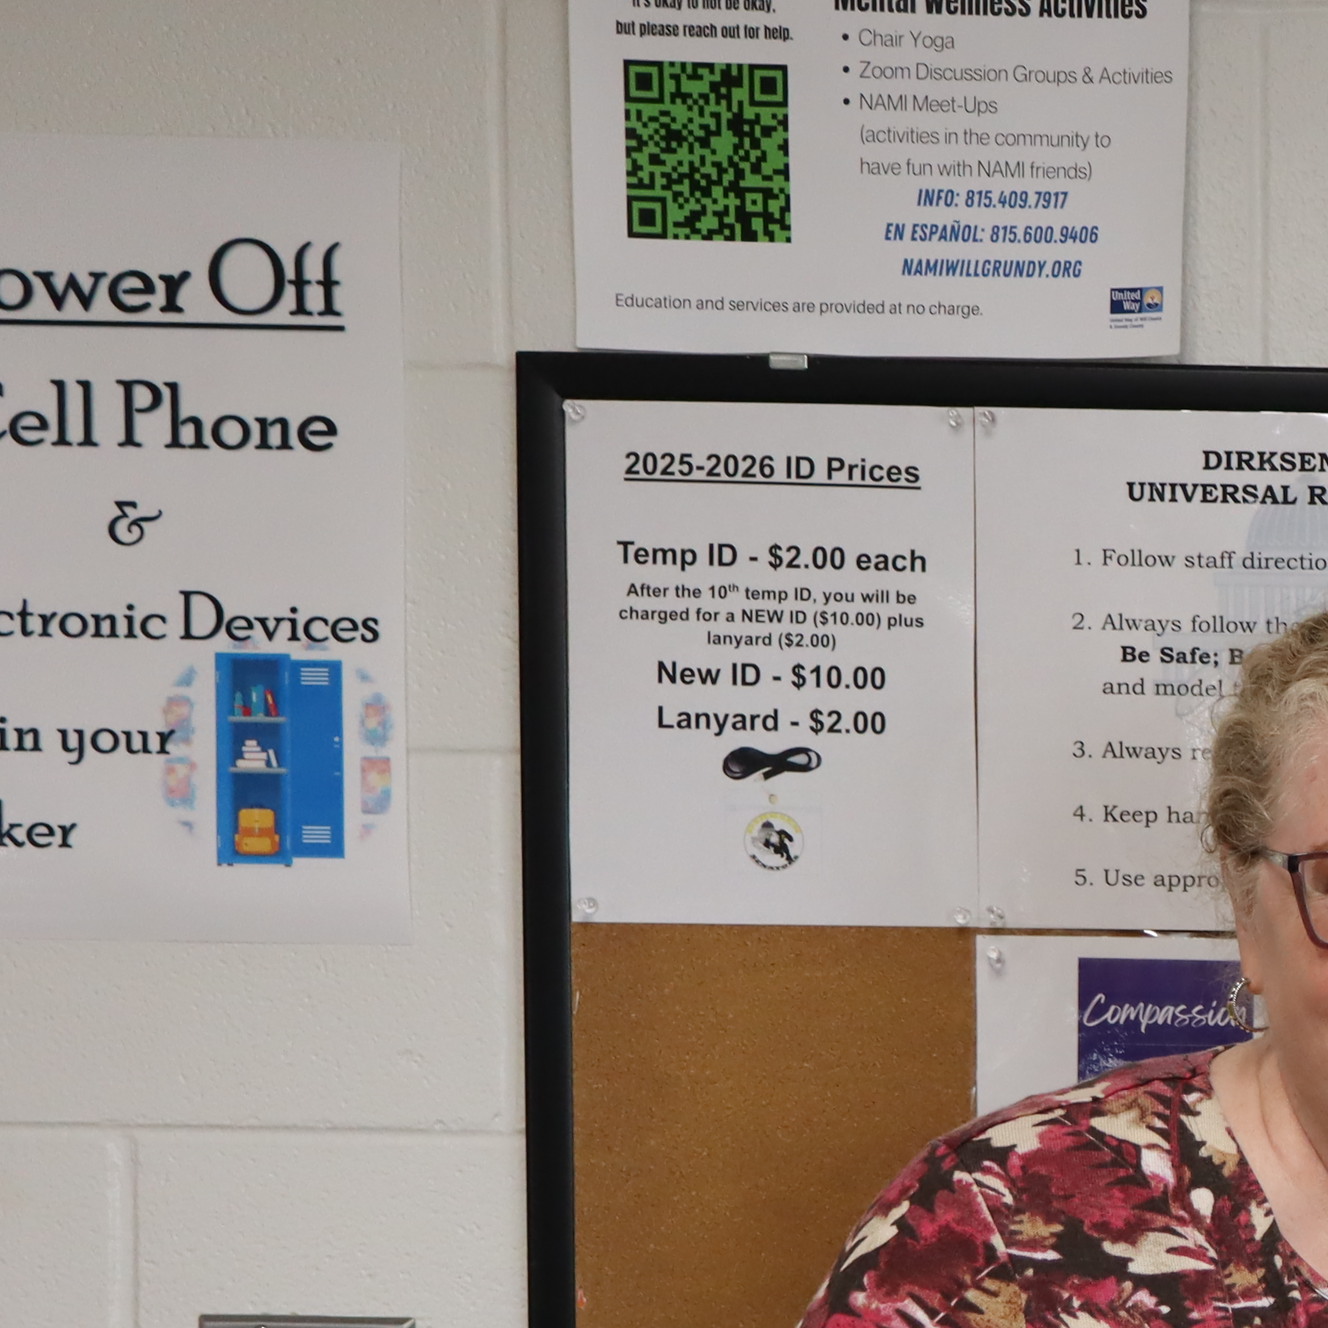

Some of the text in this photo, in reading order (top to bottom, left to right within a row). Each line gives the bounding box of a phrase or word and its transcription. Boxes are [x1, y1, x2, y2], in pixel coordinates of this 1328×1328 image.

[615, 19, 793, 43] but please reach out for help.
[859, 60, 1173, 87] Zoom Discussion Groups & Activities
[859, 92, 998, 117] NAMI Meet-Ups
[917, 188, 1068, 209] INFO: 815.409.7917
[884, 220, 1099, 244] EN ESPAÑOL: 815.600.9406
[0, 237, 343, 317] ower Off
[901, 258, 1082, 278] NAMIWILLGRUNDY.ORG
[615, 292, 983, 320] Education and services are provided at no charge.
[115, 379, 338, 452] Phone
[624, 451, 920, 484] 2025-2026 ID Prices
[1126, 481, 1298, 505] UNIVERSAL
[107, 500, 163, 547] &
[616, 540, 697, 572] Temp
[708, 543, 738, 567] ID
[767, 542, 845, 571] $2.00
[855, 549, 926, 573] each
[1074, 548, 1091, 566] 1.
[1102, 548, 1176, 568] Follow
[1184, 550, 1236, 570] staff
[626, 582, 669, 598] After
[674, 583, 702, 599] the
[744, 586, 788, 604] temp
[794, 587, 816, 604] ID,
[822, 591, 855, 606] you
[860, 589, 890, 604] will
[895, 589, 917, 605] be
[0, 590, 380, 647] ctronic Devices
[618, 605, 924, 631] charged for a NEW ID ($10.00) plus
[56, 727, 174, 765] your
[0, 800, 77, 848] ker
[1083, 993, 1247, 1033] Compassion
